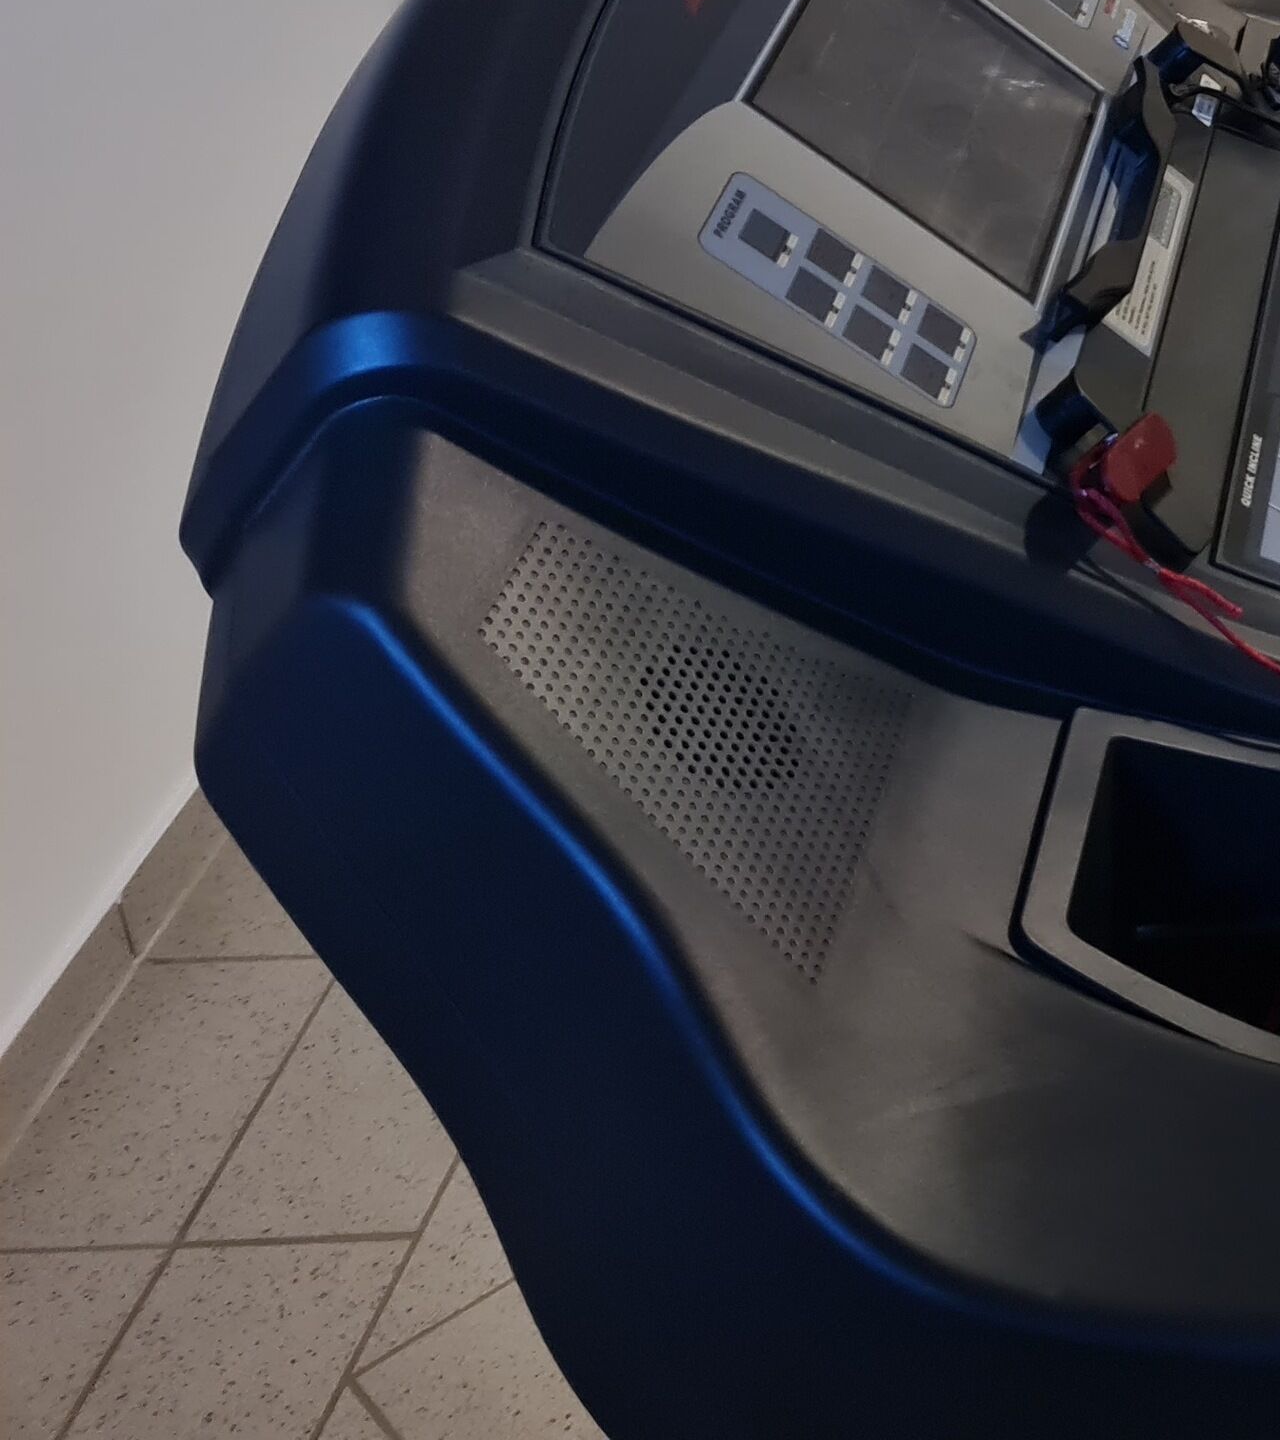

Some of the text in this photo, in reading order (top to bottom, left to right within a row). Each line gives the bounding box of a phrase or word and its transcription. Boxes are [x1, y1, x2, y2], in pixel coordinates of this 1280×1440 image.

[712, 188, 747, 239] PROGRAM
[1240, 433, 1263, 508] QUICK INCLINE
